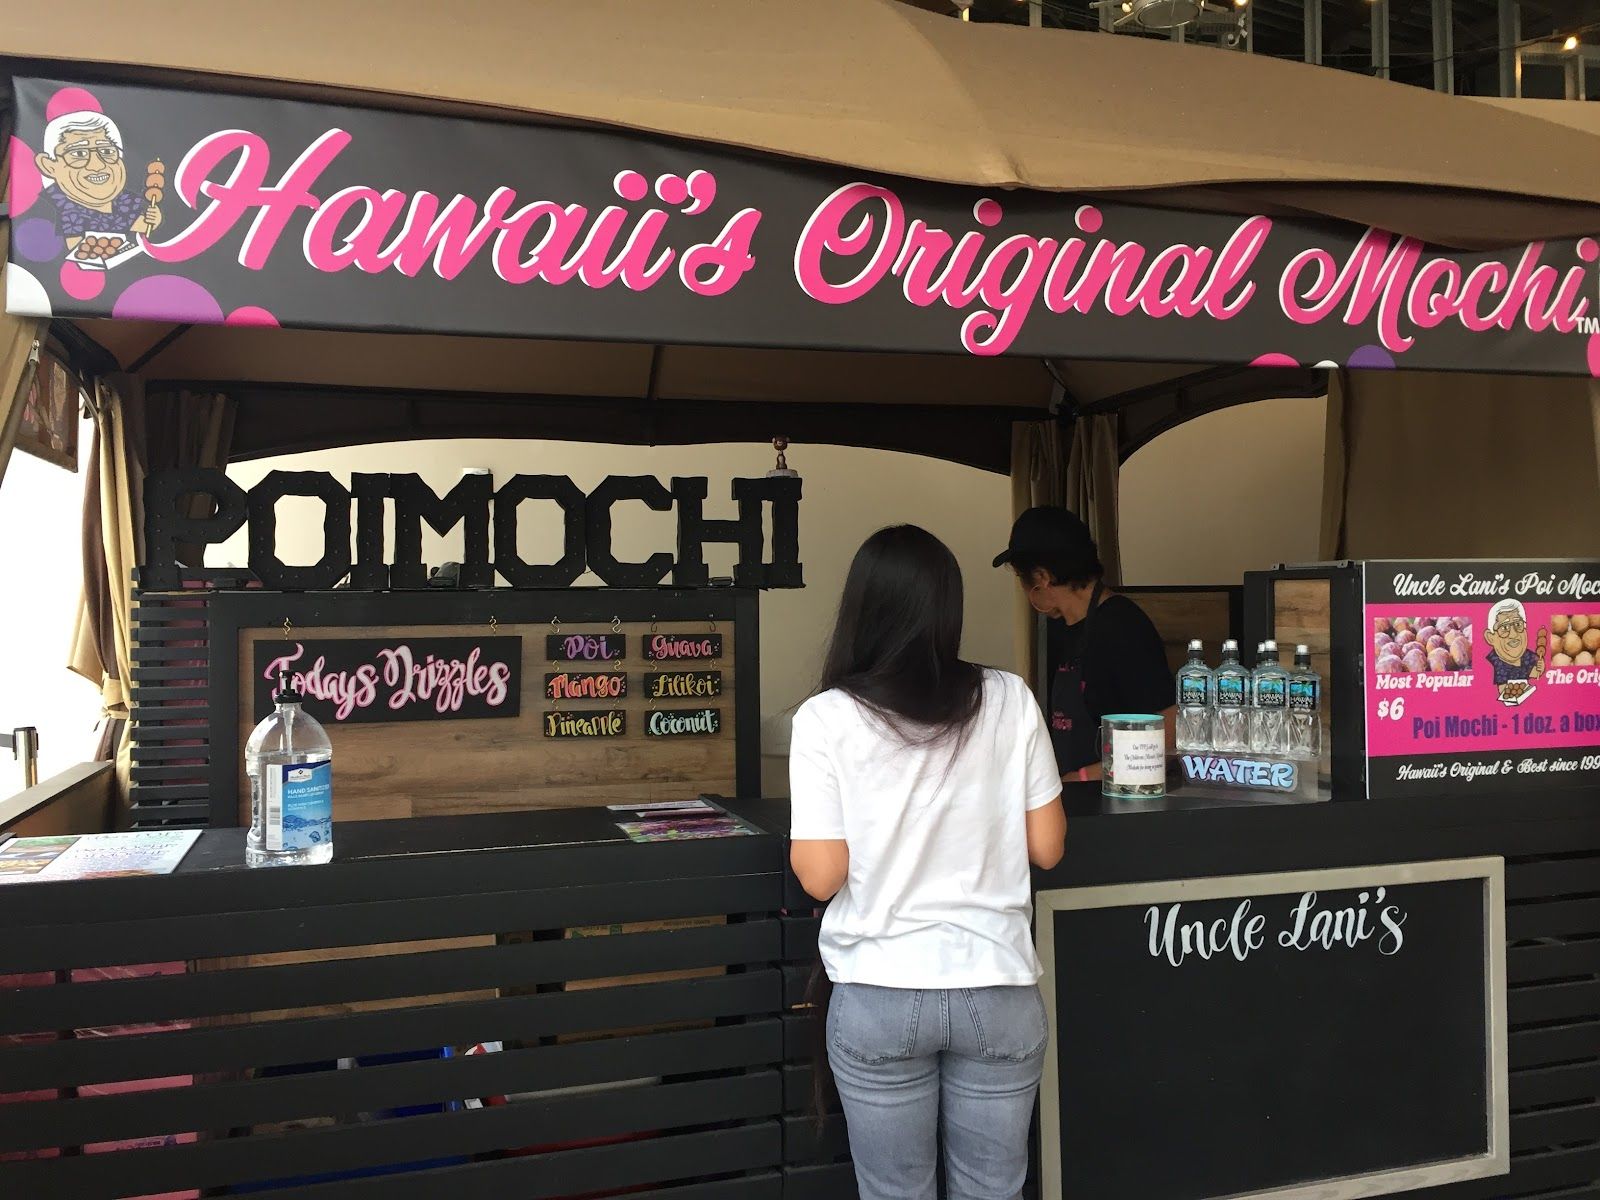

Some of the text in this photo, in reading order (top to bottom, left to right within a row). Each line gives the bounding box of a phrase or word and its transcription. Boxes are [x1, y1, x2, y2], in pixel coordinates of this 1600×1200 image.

[139, 127, 1600, 356] Hawaii's Original Mochi
[1575, 316, 1600, 334] TM
[1393, 572, 1447, 597] Uncle
[1449, 572, 1511, 597] Lani's
[1514, 571, 1556, 596] Poi
[563, 634, 615, 660] Poi
[651, 634, 713, 660] Guava
[376, 644, 511, 714] Drizzles
[549, 673, 625, 699] Mango
[652, 673, 715, 697] Lilikoi
[1375, 671, 1475, 693] Most Popular
[1545, 668, 1600, 687] The Ori
[1377, 696, 1405, 721] $6
[547, 710, 623, 737] Pineapple
[650, 709, 716, 736] Coconut
[1412, 717, 1441, 739] Poi
[1445, 714, 1499, 738] Mochi
[1511, 713, 1520, 735] 1
[1523, 712, 1556, 734] doz.
[1560, 714, 1571, 733] a
[1181, 755, 1294, 788] WATER
[1396, 762, 1448, 781] Hawaii's
[1450, 760, 1501, 782] Original
[1501, 759, 1514, 775] &
[1517, 758, 1549, 774] Best
[1549, 758, 1578, 773] since
[288, 787, 306, 796] HAND
[1143, 886, 1408, 967] Uncle Lani's
